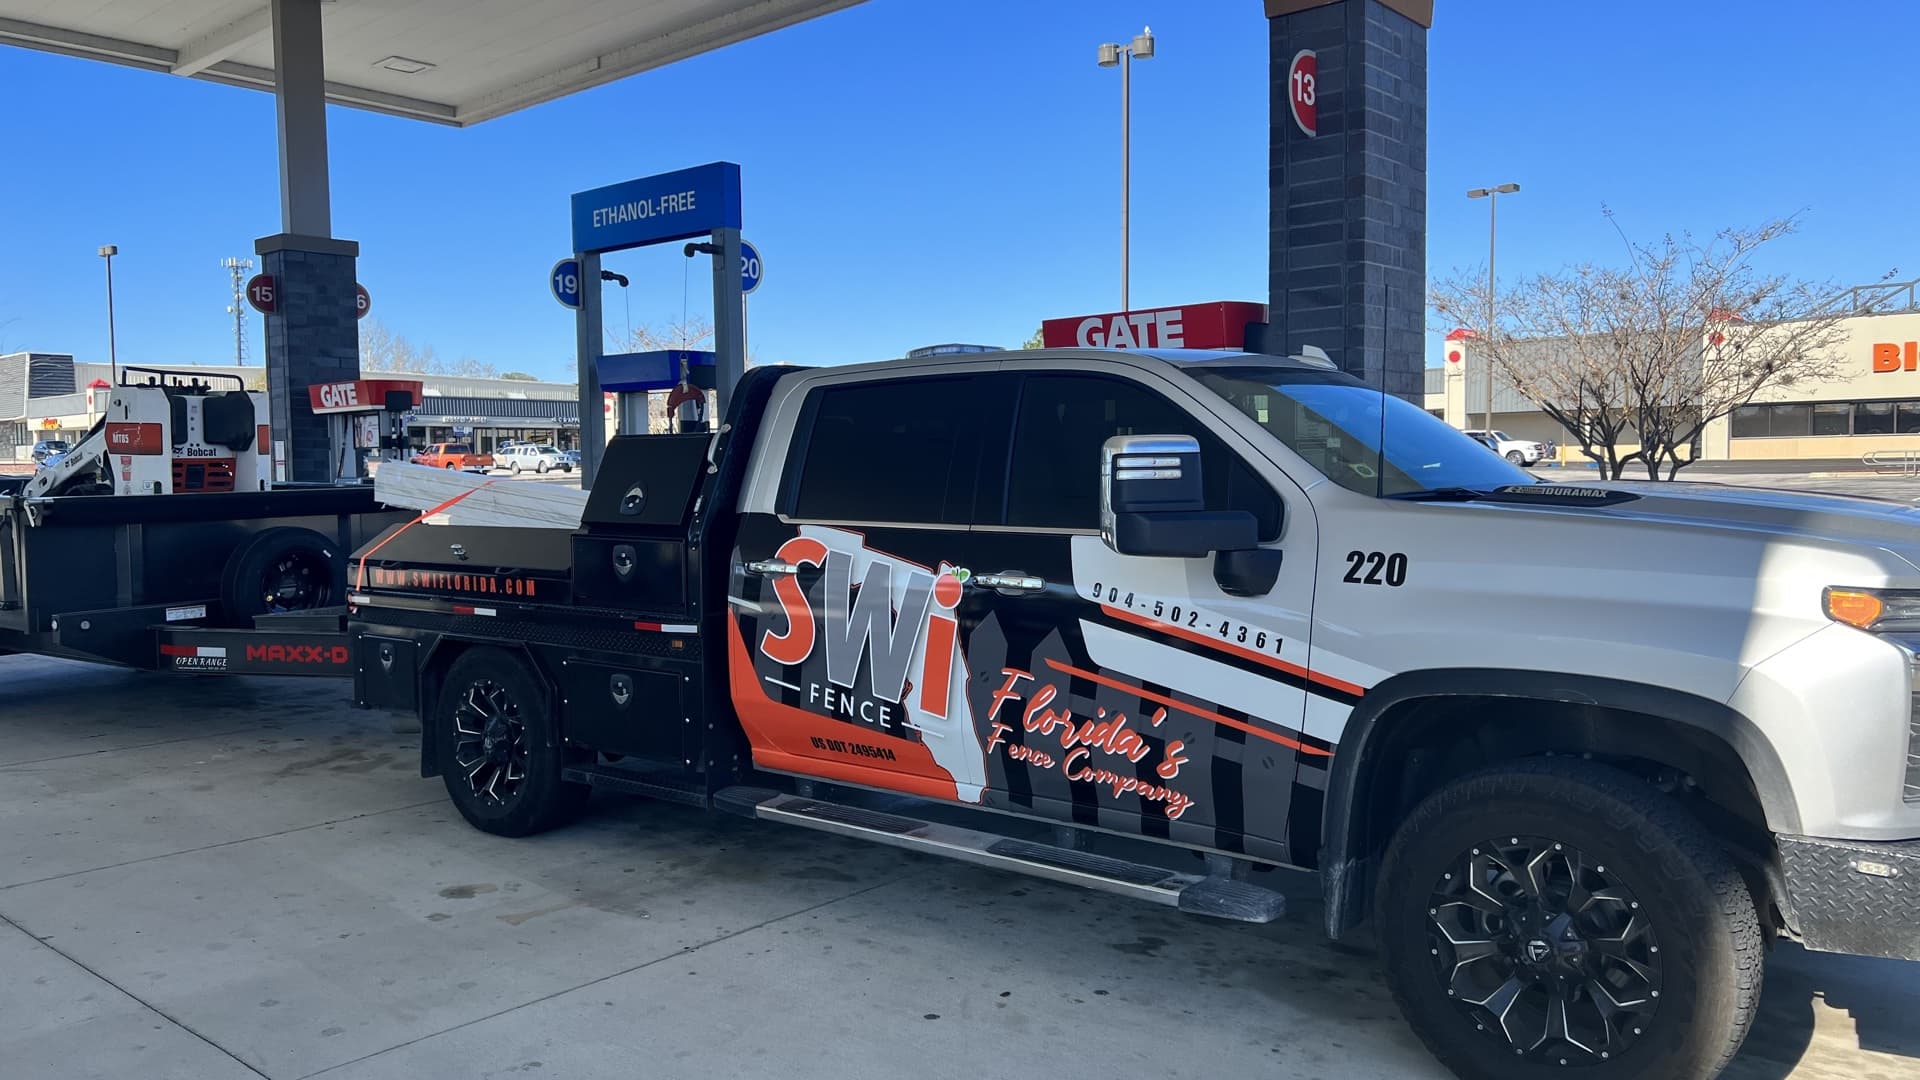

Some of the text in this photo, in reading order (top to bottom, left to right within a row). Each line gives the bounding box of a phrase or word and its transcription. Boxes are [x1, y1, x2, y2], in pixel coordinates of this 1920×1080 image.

[1293, 70, 1316, 106] 13
[592, 190, 697, 229] ETHANOL-FREE
[740, 256, 760, 279] 20
[251, 286, 273, 302] 15
[555, 274, 578, 295] 19
[356, 294, 367, 309] 6
[1076, 309, 1185, 349] GATE
[1872, 341, 1920, 373] BI
[320, 382, 358, 408] GATE
[186, 447, 217, 457] Bobcat
[1545, 488, 1608, 497] DURAMAX
[1343, 550, 1408, 587] 220
[375, 569, 536, 597] WWW.SWIFLORIDA.COM
[1092, 582, 1284, 655] 904-502-4361
[175, 656, 228, 667] OPEN RANGE
[246, 644, 349, 664] MAXX-D
[809, 683, 892, 729] FENCE
[987, 667, 1190, 780] Florida's
[810, 737, 896, 761] US DOT 2495414
[986, 722, 1195, 820] Fence Company
